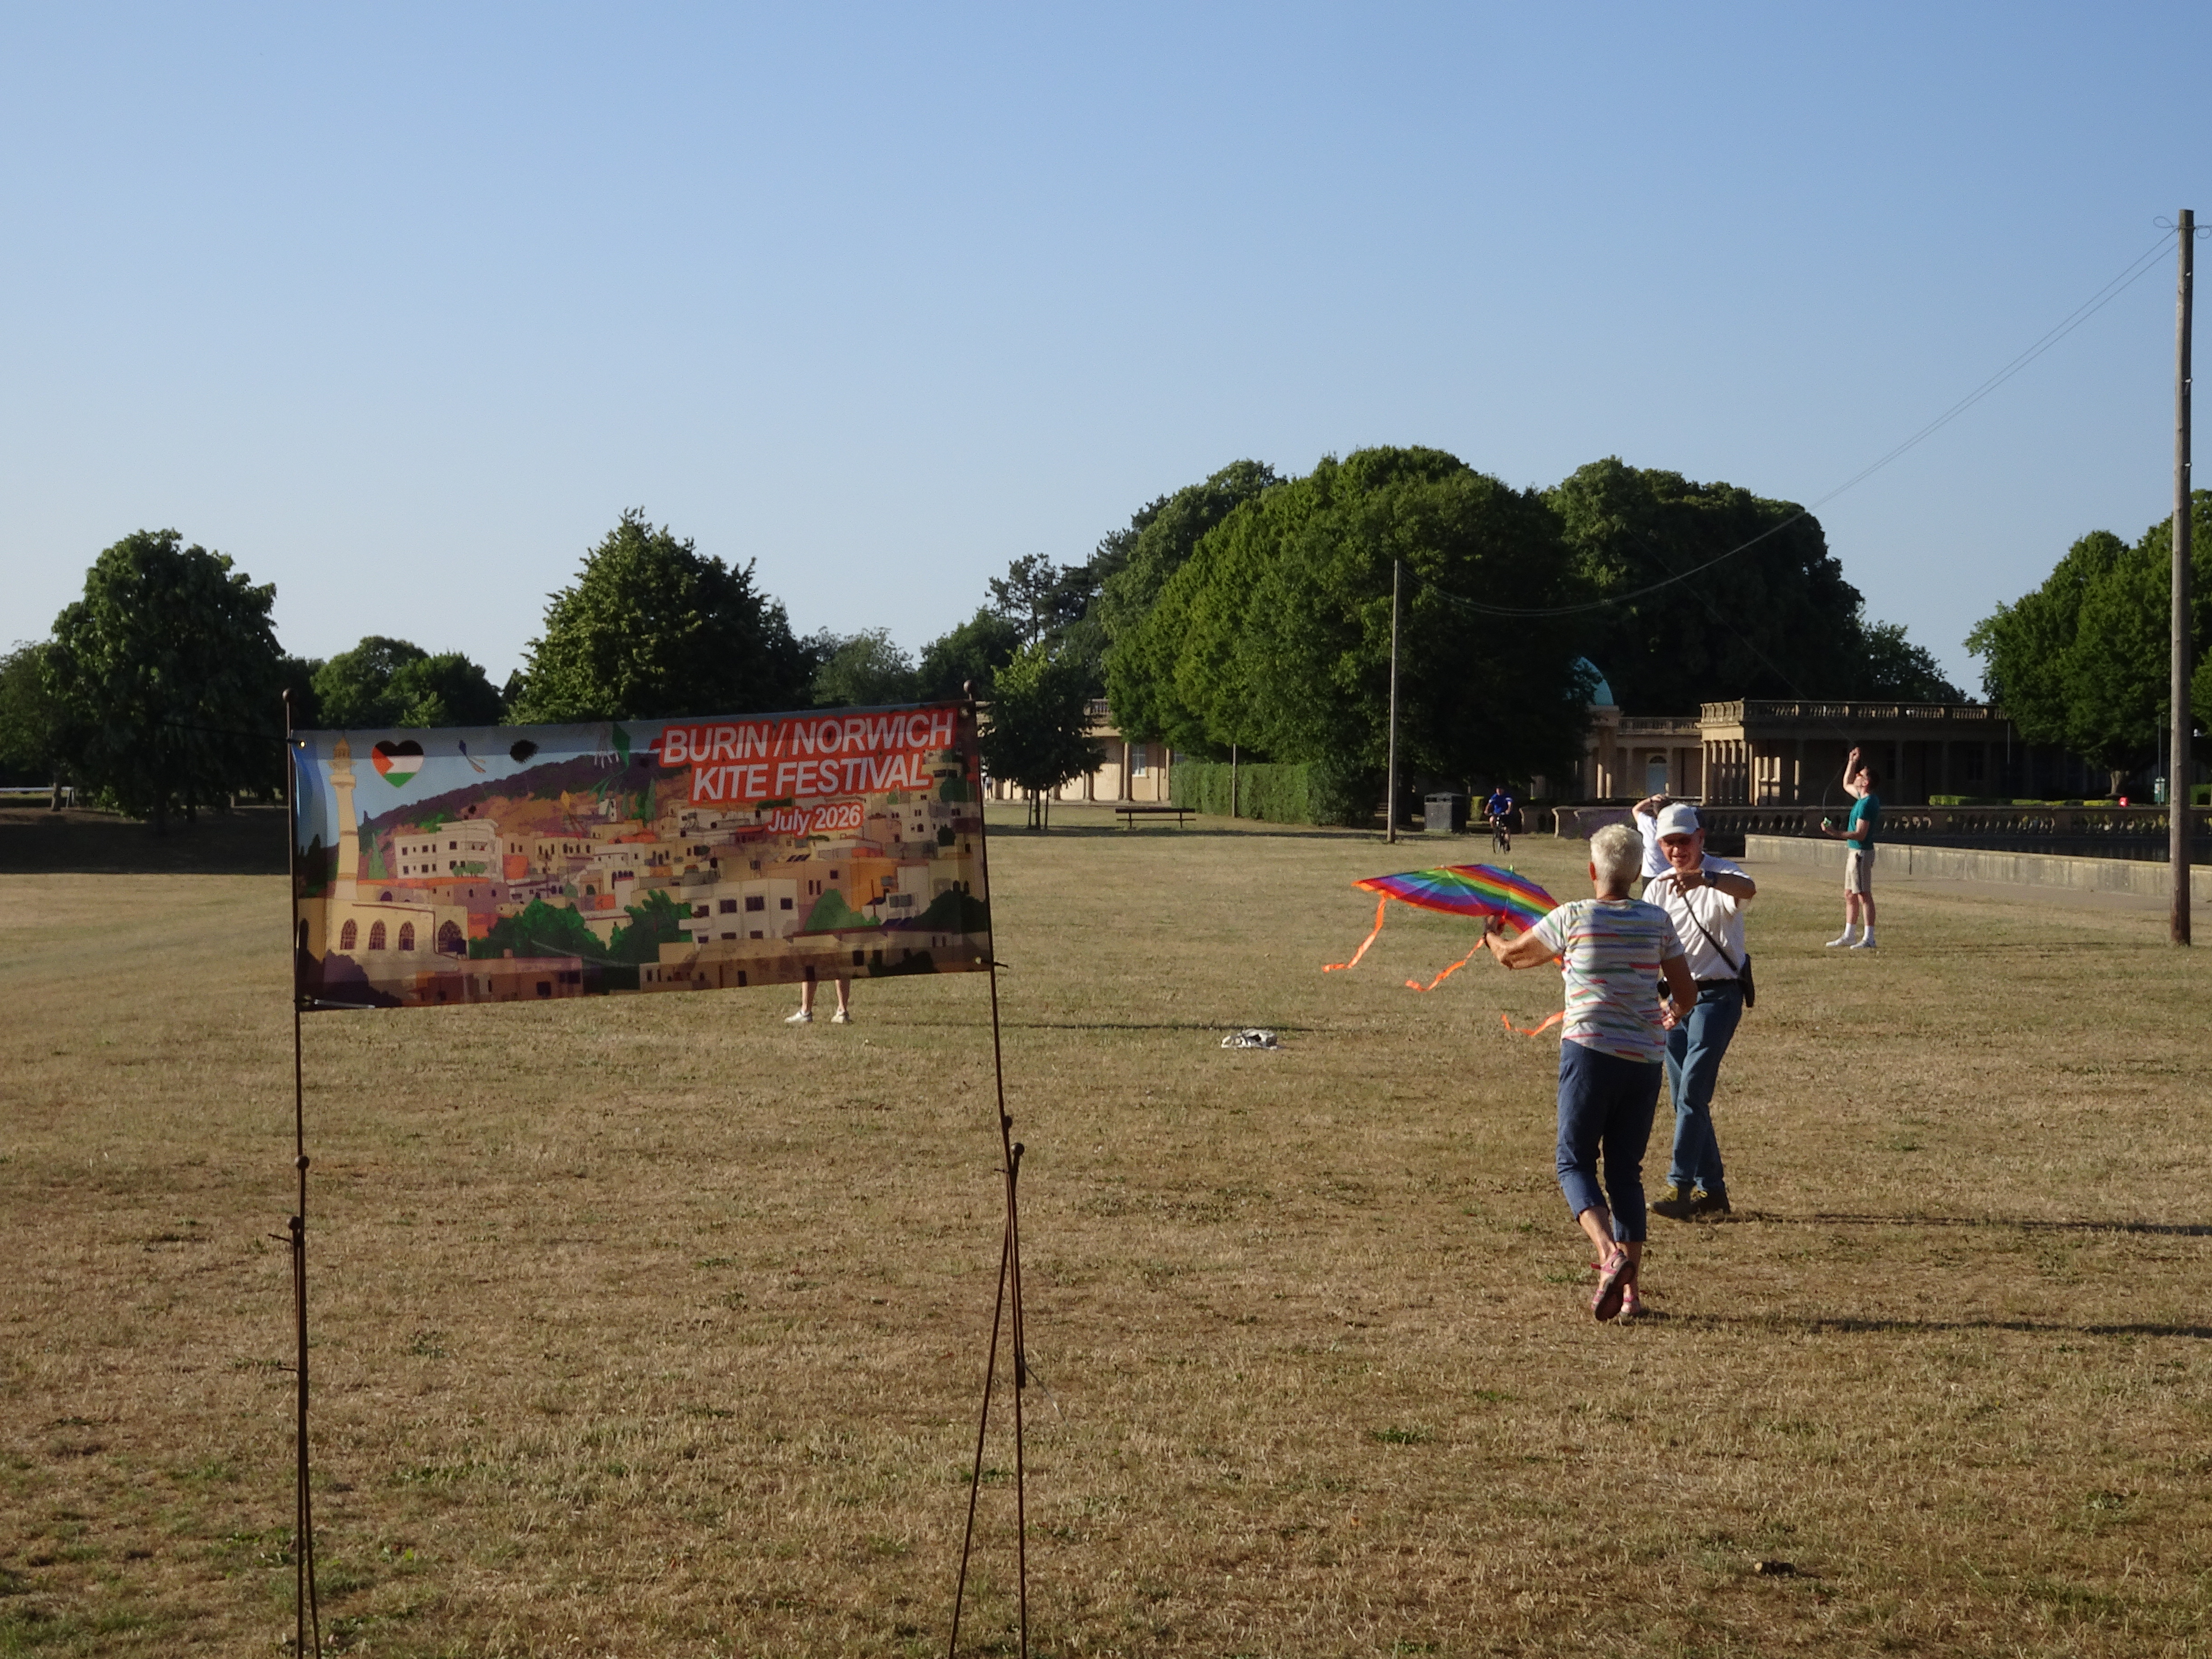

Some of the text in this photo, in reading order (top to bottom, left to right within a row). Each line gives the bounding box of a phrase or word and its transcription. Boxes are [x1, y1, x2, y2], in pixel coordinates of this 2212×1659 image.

[664, 724, 770, 763] BURIN
[792, 712, 954, 755] NORWICH
[693, 754, 929, 802] KITE FESTIVAL
[768, 805, 861, 836] July 2026
